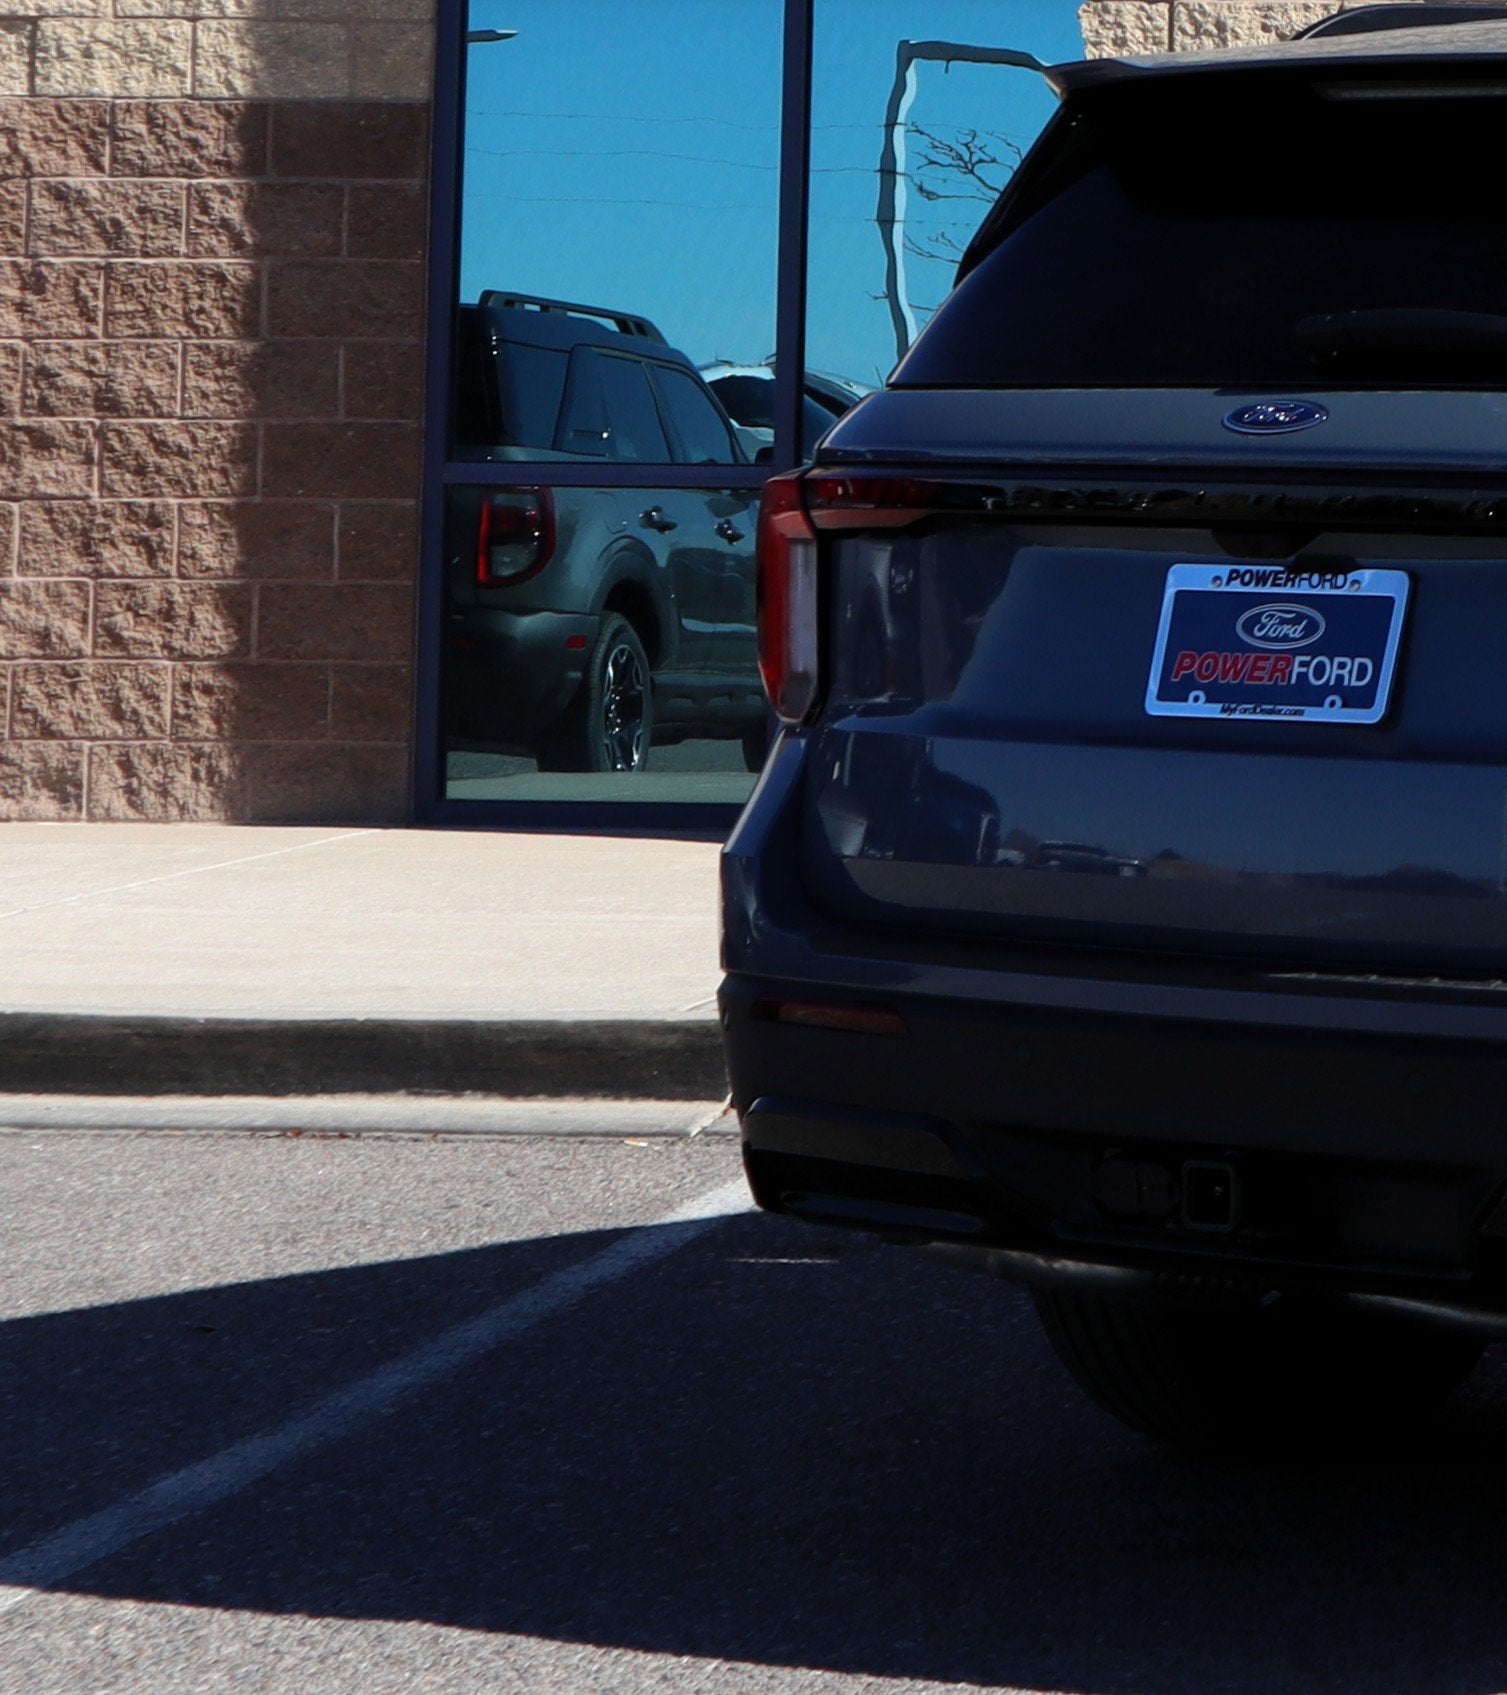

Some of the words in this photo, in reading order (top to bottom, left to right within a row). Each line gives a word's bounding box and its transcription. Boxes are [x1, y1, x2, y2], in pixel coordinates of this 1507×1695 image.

[1225, 569, 1348, 590] POWERFORD
[1253, 609, 1308, 639] Ford
[1170, 650, 1373, 687] POWERFORD
